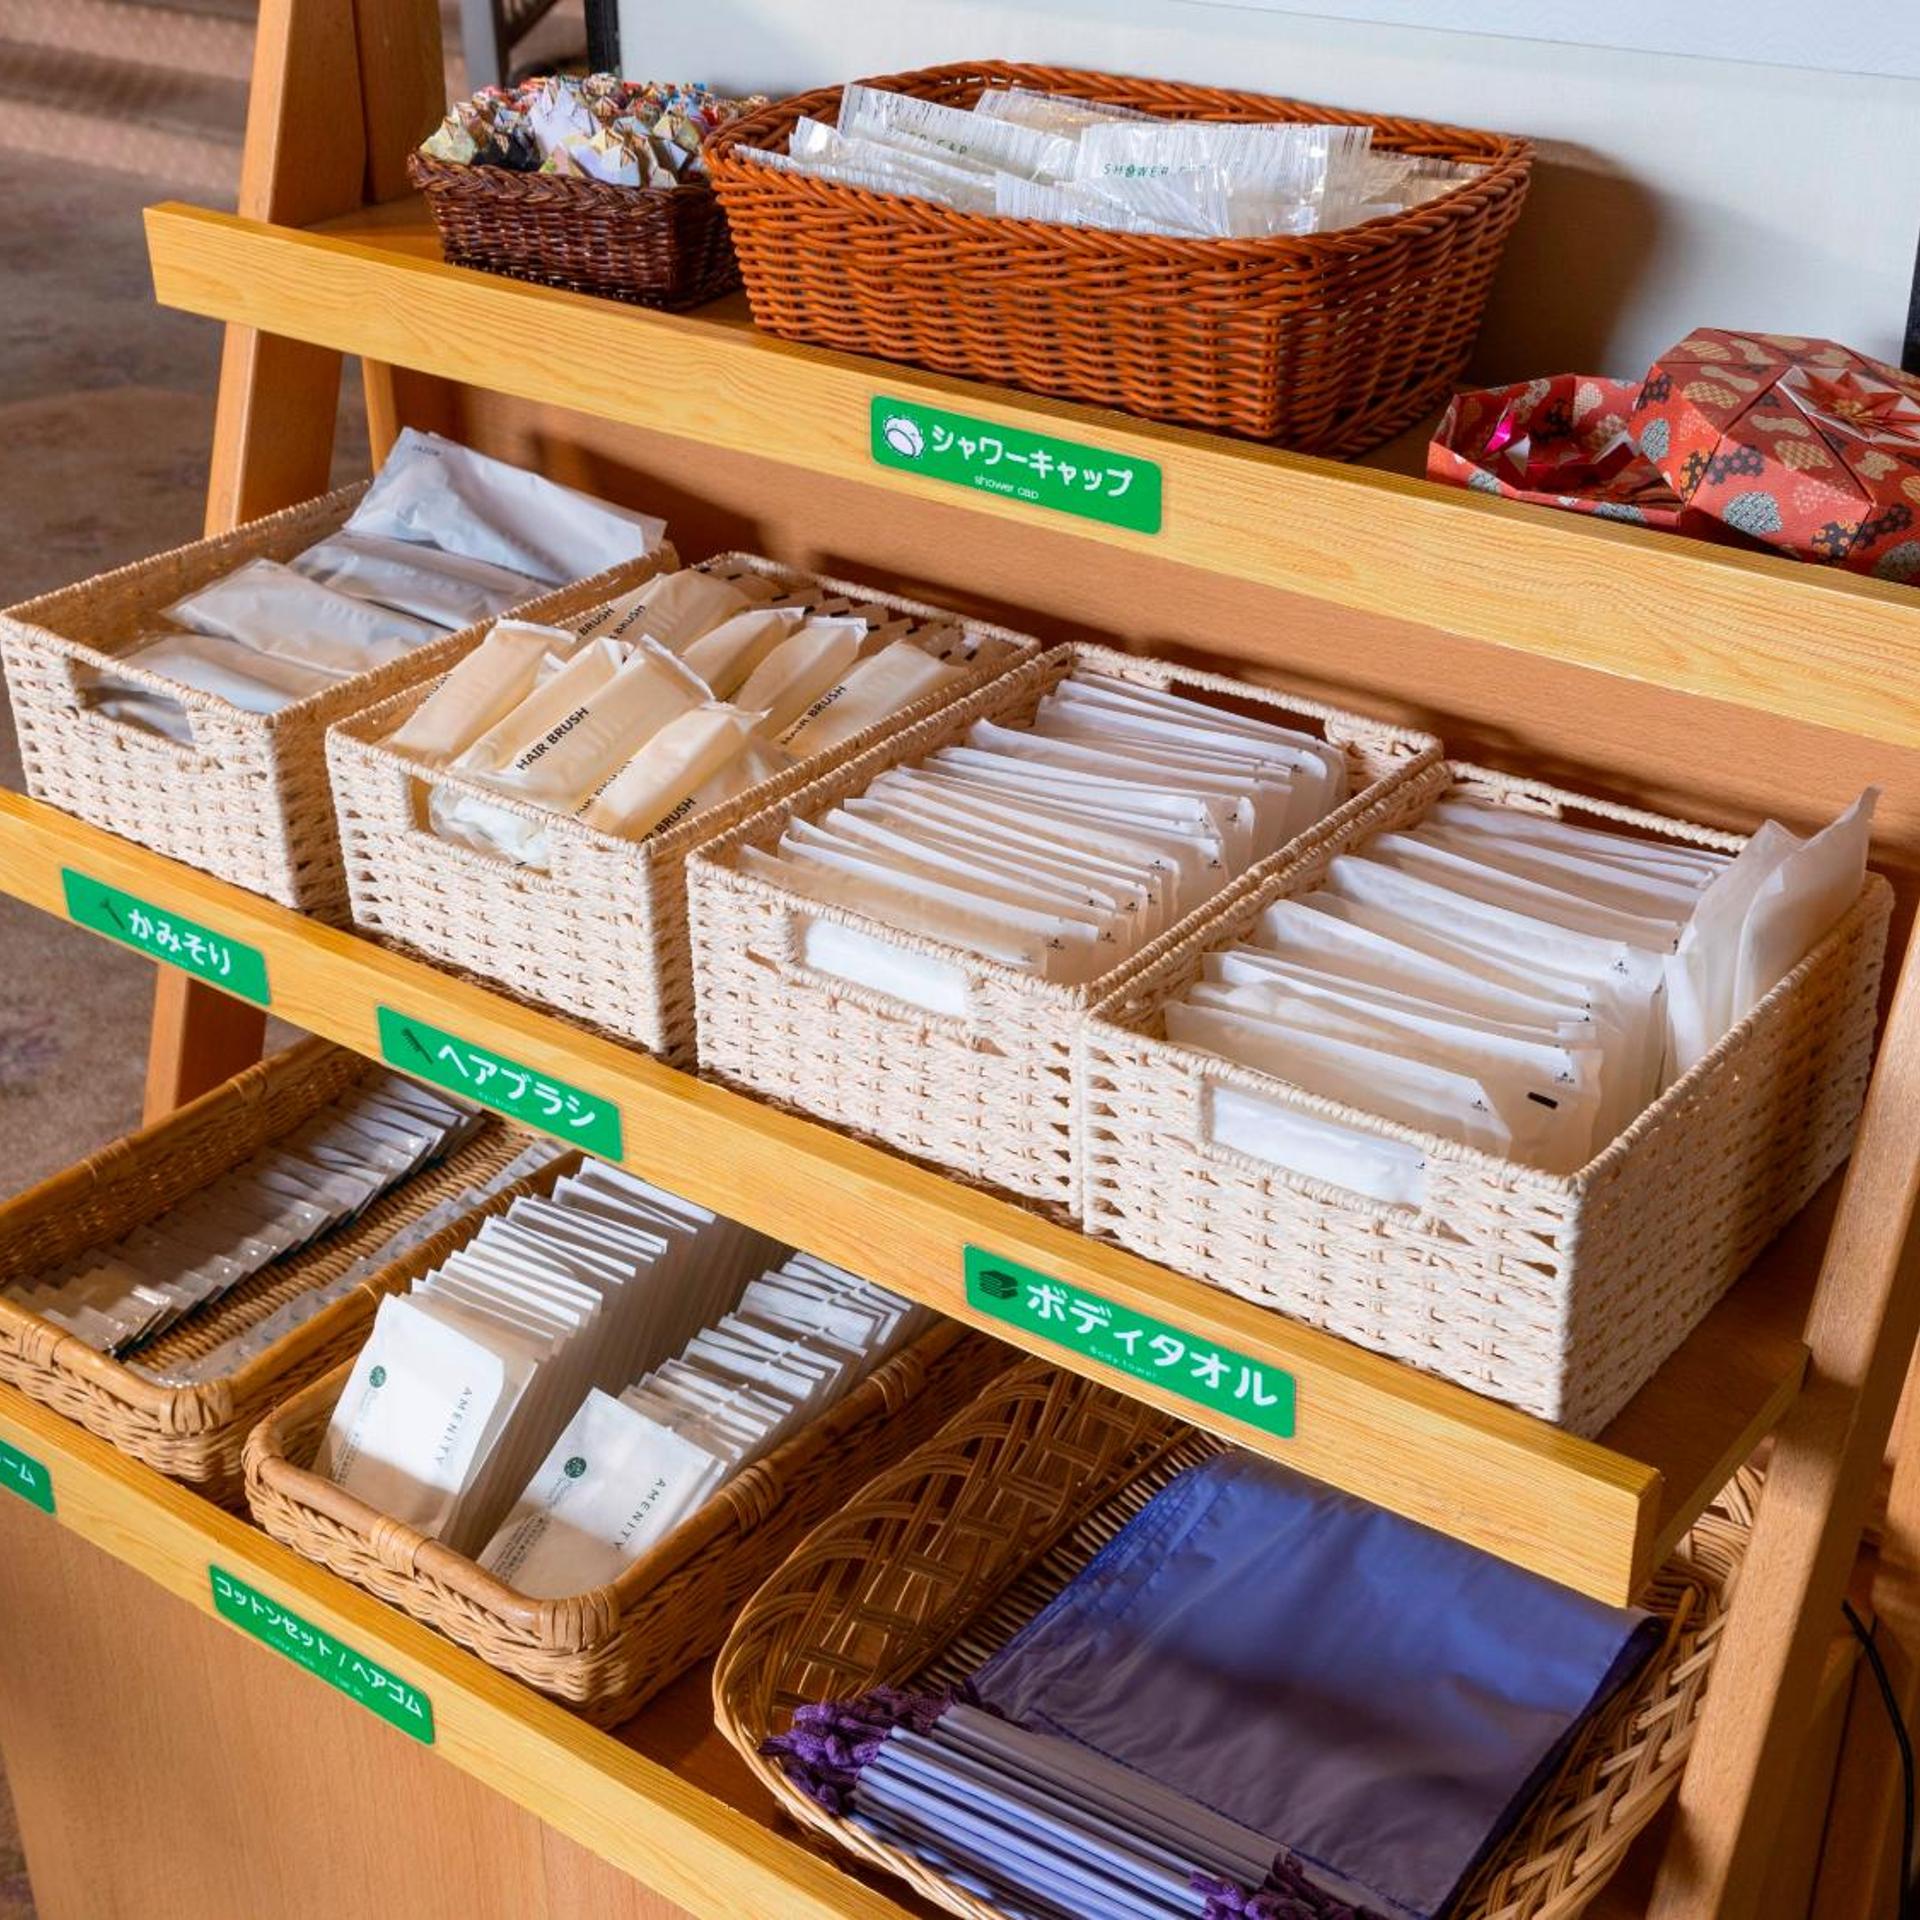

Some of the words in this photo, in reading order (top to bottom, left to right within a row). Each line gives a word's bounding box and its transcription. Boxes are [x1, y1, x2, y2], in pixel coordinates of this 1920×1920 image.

[931, 424, 1133, 496] シャワーキャップ
[973, 473, 1014, 492] shower
[807, 685, 846, 718] BRUSH
[515, 742, 550, 770] HAIR
[546, 707, 590, 745] BRUSH
[654, 797, 697, 835] BRUSH
[129, 908, 231, 975] かみそり
[437, 1044, 596, 1128] ヘアブラシ
[1026, 1284, 1278, 1406] ボディタオル
[432, 1386, 473, 1466] AMENITY
[613, 1477, 667, 1552] AMENITY
[215, 1576, 333, 1657] コットンセット
